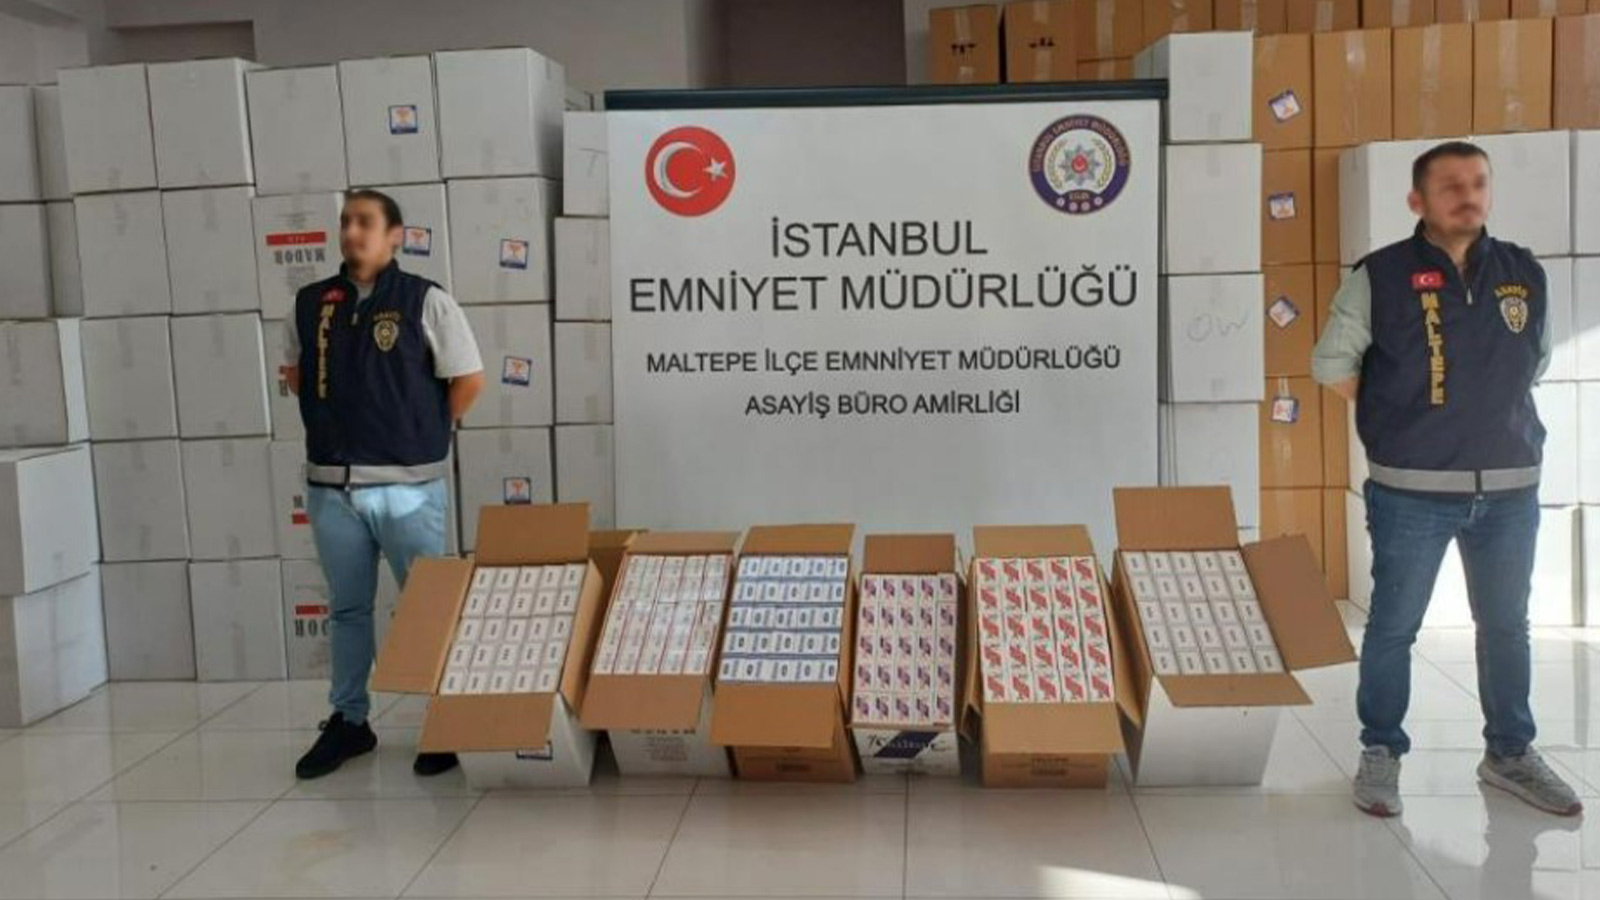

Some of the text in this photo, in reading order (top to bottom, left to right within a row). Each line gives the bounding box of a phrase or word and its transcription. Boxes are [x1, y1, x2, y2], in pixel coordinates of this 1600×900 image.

[772, 216, 988, 258] İSTANBUL
[273, 247, 327, 266] MADOR
[629, 264, 1137, 313] EMNİYET MÜDÜRLÜĞÜ
[646, 344, 1121, 377] MALTEPE İLÇE EMNNİYET MÜDÜRLÜĞÜ
[1420, 292, 1445, 405] MALTEPE
[744, 389, 1020, 420] ASAYİŞ BÜRO AMİRLİĞİ
